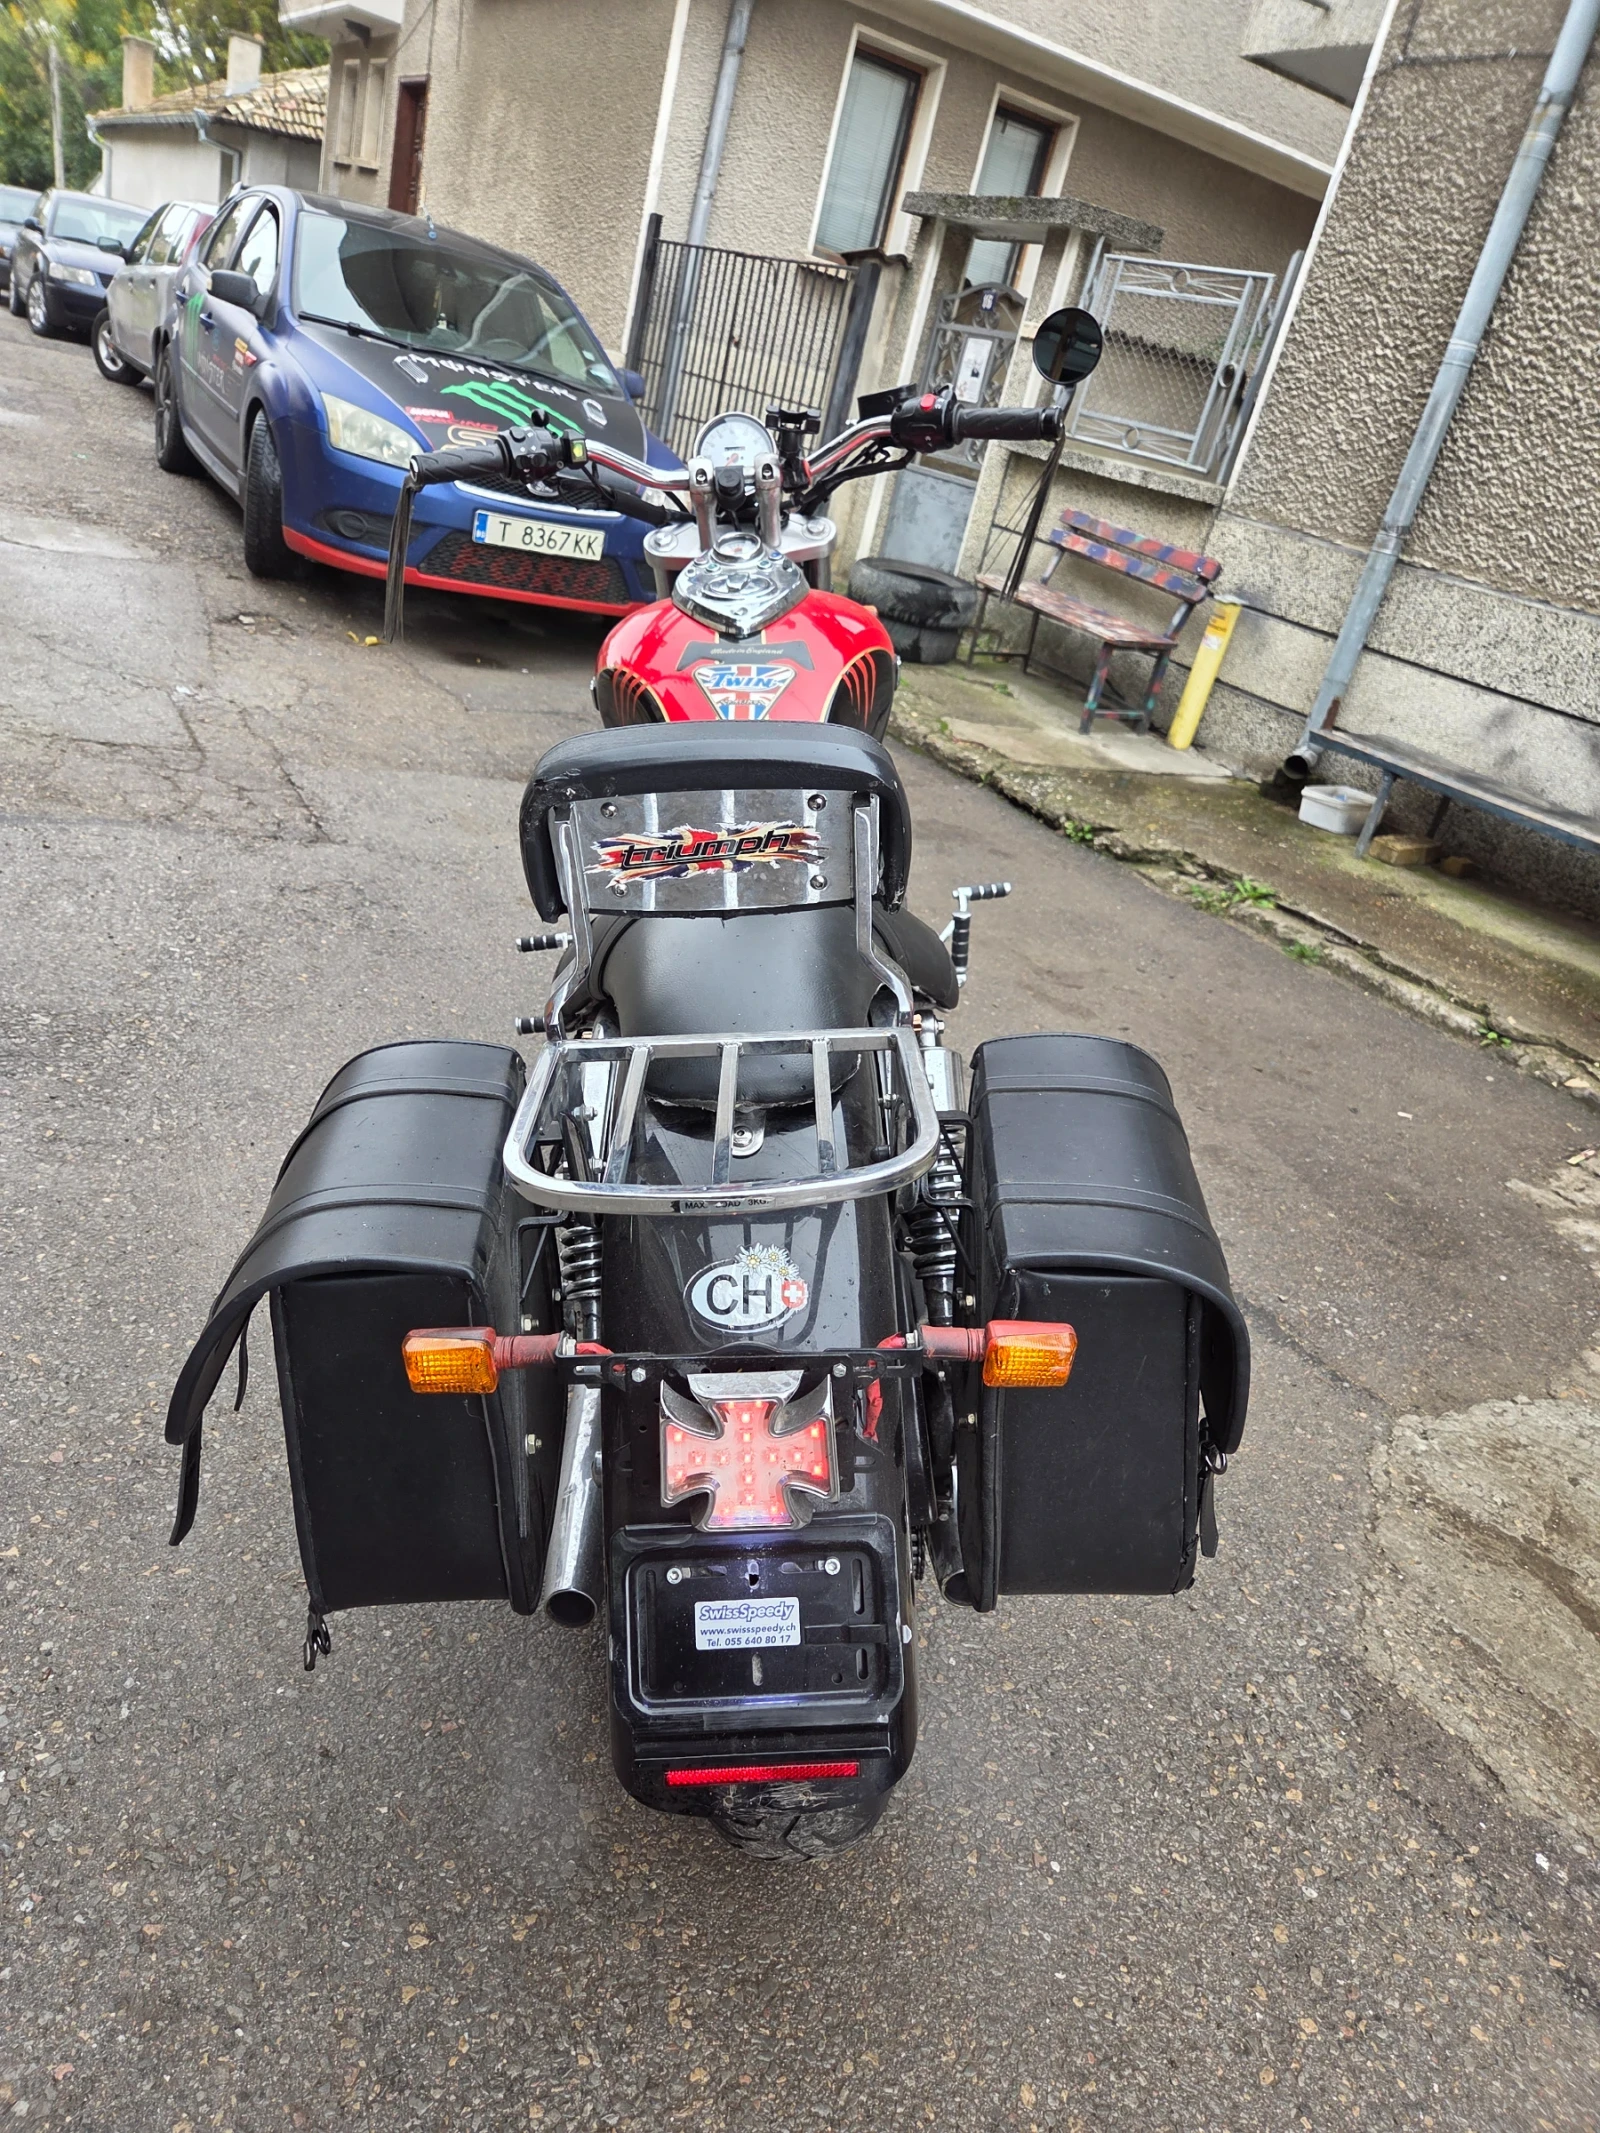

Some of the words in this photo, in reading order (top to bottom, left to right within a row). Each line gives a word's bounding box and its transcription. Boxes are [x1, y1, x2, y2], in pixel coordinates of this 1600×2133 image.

[499, 521, 512, 542] T
[450, 544, 610, 595] FORD
[706, 1274, 772, 1316] CH
[699, 1601, 795, 1622] SwissSpeedy
[700, 1623, 796, 1635] www.swissspeedy.ch
[707, 1638, 722, 1647] Tel.
[724, 1638, 742, 1646] 055
[744, 1636, 762, 1645] 640
[765, 1635, 777, 1644] 80
[780, 1635, 791, 1643] 17
